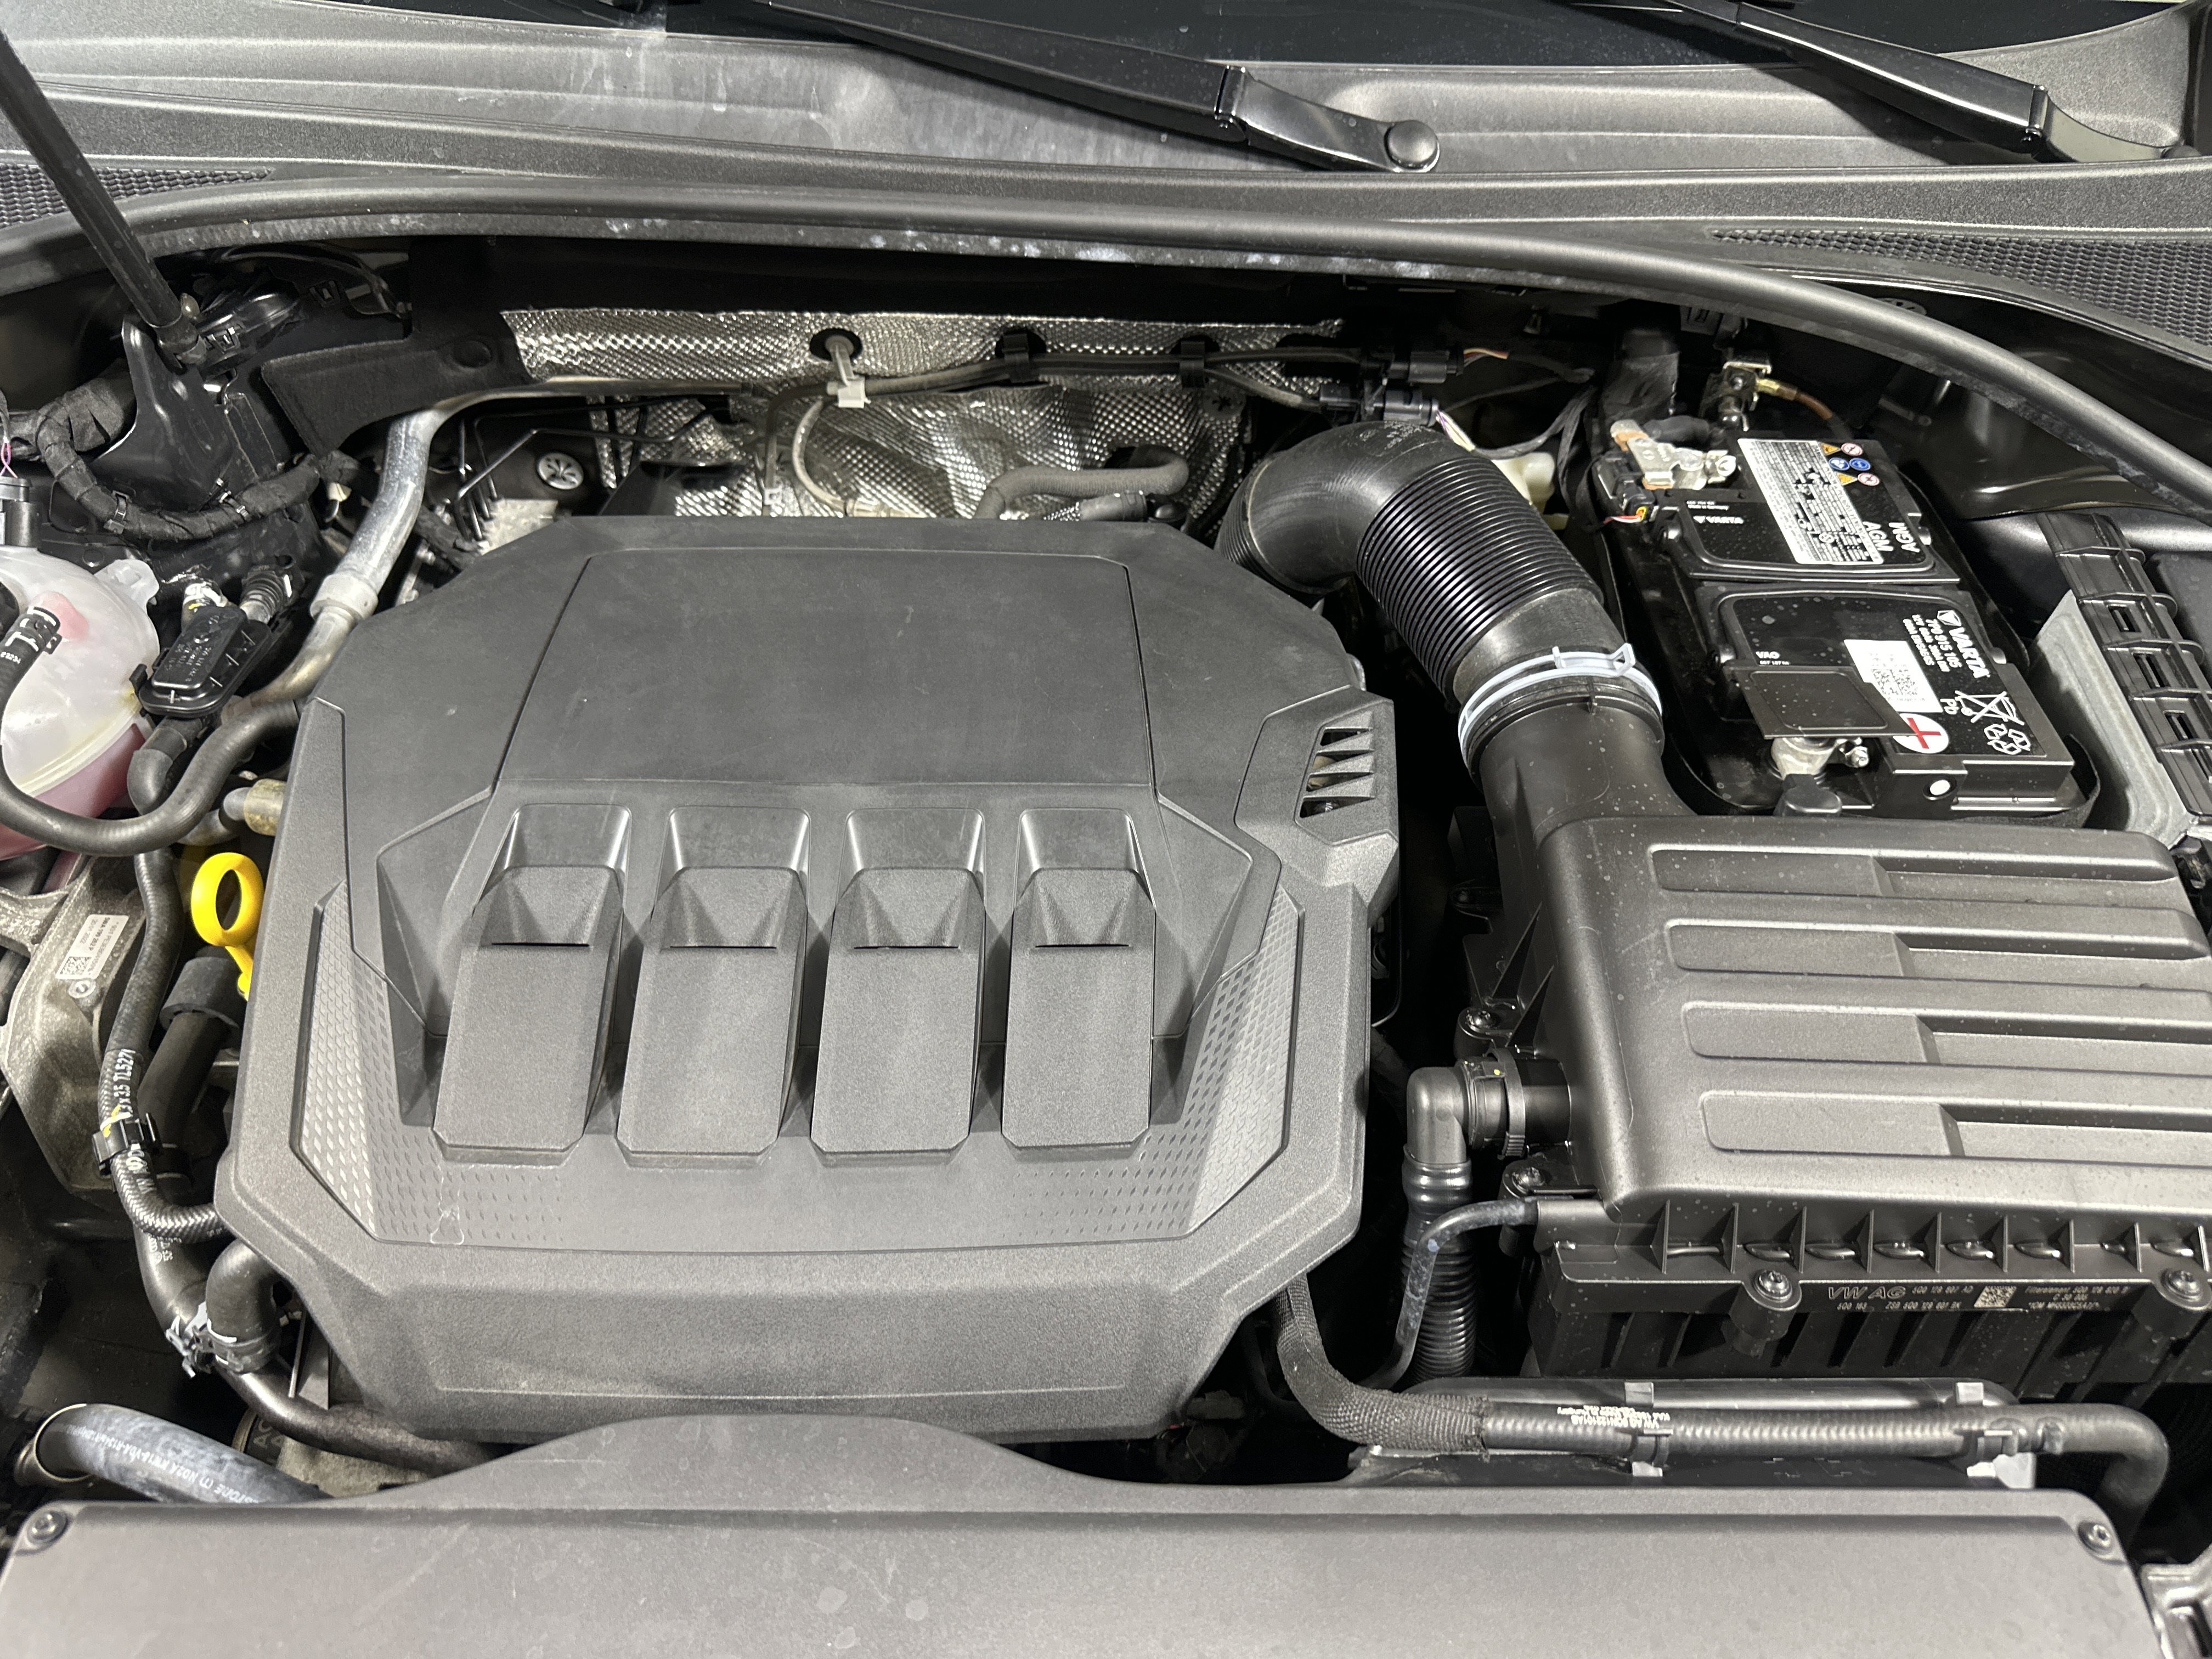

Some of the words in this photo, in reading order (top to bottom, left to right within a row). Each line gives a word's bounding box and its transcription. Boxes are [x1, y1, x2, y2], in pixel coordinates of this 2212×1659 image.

[1706, 516, 1744, 524] VARTA
[1863, 522, 1893, 551] AGM
[1889, 523, 1920, 553] AGM
[1926, 619, 1943, 636] 7P0
[1934, 635, 1953, 651] 915
[1944, 652, 1962, 668] 105
[1949, 627, 1989, 678] VARTA
[1940, 698, 1959, 715] Pb
[1829, 1286, 1867, 1299] VW
[1868, 1286, 1906, 1299] AG
